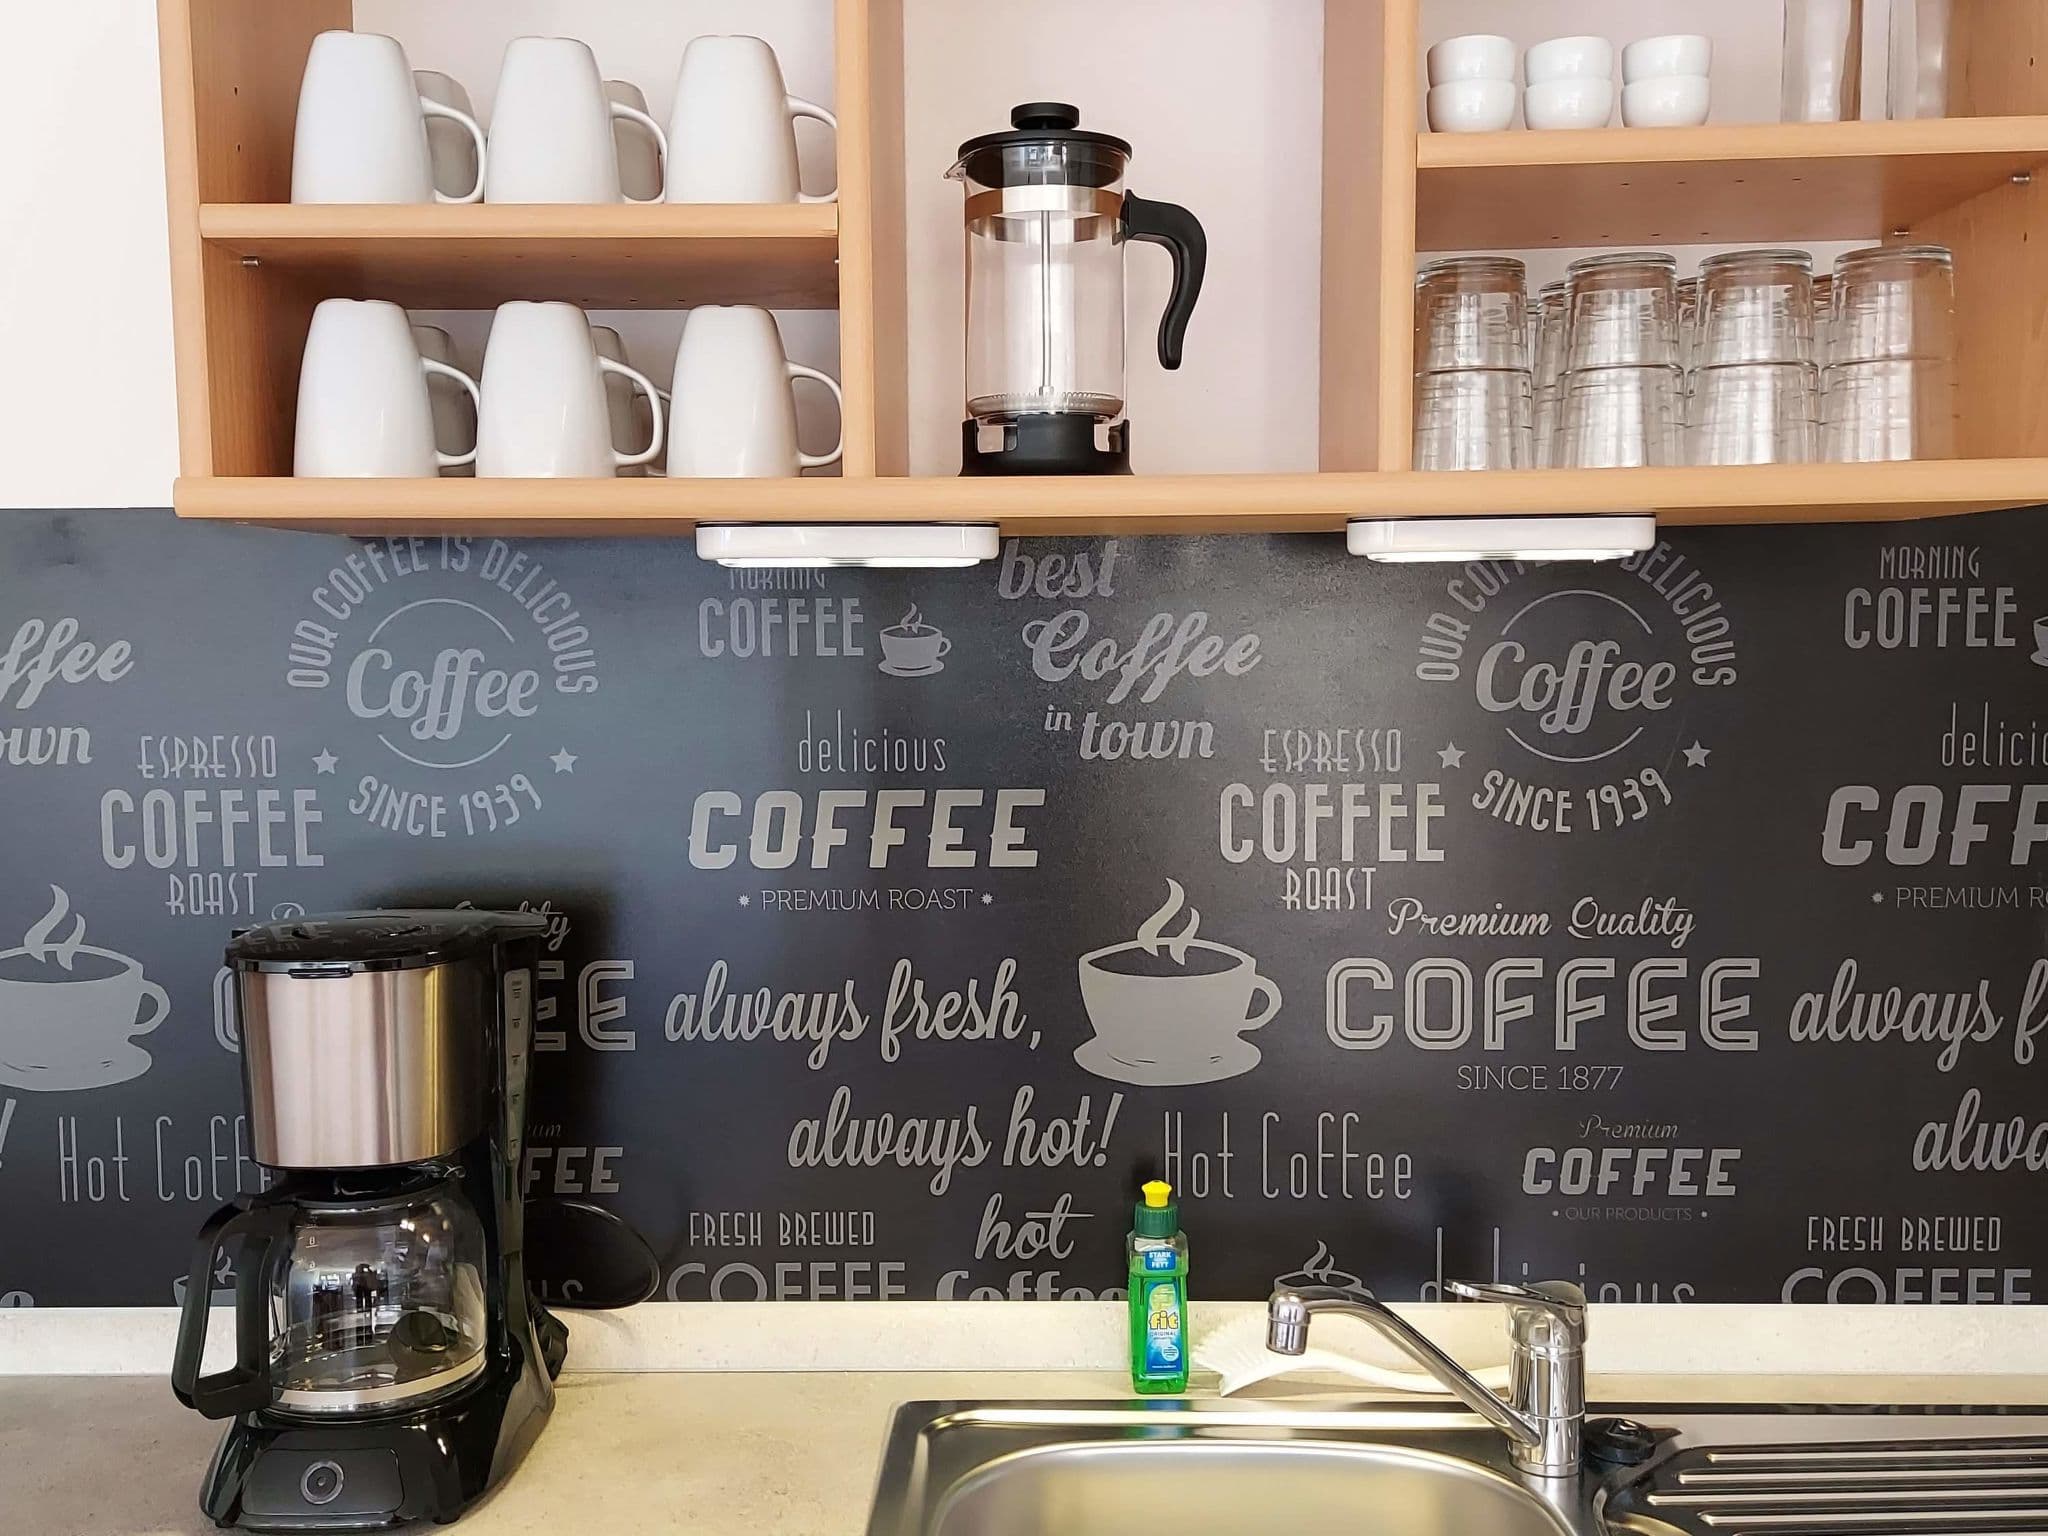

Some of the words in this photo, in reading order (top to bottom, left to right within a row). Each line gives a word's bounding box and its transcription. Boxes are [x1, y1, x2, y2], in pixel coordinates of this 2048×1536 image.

[312, 535, 430, 621] COFFEE
[441, 535, 473, 573] IS
[999, 537, 1122, 600] best
[1880, 546, 1981, 580] MORNING
[480, 538, 600, 694] DELICIOUS
[698, 597, 865, 658] COFFEE
[1415, 612, 1471, 682] OUR
[1843, 586, 2018, 649] COFFEE
[286, 620, 339, 689] OUR
[1021, 609, 1264, 705] Coffee
[346, 648, 540, 741] Coffee
[1474, 639, 1677, 735] Coffee
[137, 735, 278, 779] ESPRESSO
[798, 709, 948, 774] delicious
[1045, 704, 1072, 732] in
[1079, 712, 1216, 761] town
[1258, 728, 1403, 774] ESPRESSO
[100, 788, 325, 869] COFFEE
[348, 775, 447, 838] SINCE
[459, 773, 543, 836] 1939
[688, 789, 1047, 869] COFFEE
[1218, 783, 1446, 865] COFFEE
[1472, 769, 1574, 834] SINCE
[1586, 767, 1673, 831] 1939
[165, 872, 259, 917] ROAST
[761, 889, 879, 913] PREMIUM
[888, 888, 974, 910] ROAST
[1281, 867, 1377, 912] ROAST
[1896, 887, 2019, 909] PREMIUM
[1388, 896, 1552, 939] Premium
[1566, 896, 1697, 950] Quality
[664, 959, 871, 1071] always
[880, 957, 1043, 1064] fresh,
[1324, 957, 1761, 1052] COFFEE
[1788, 957, 2004, 1073] always
[1456, 1065, 1548, 1092] SINCE
[1558, 1065, 1624, 1091] 1877
[58, 1116, 131, 1202] Hot
[155, 1115, 272, 1202] Coff
[786, 1085, 993, 1197] always
[1002, 1084, 1125, 1168] hot!
[1164, 1110, 1235, 1199] Hot
[1262, 1111, 1413, 1200] Coffee
[1579, 1114, 1680, 1140] Premium
[523, 1146, 624, 1195] FEE
[1522, 1147, 1742, 1196] COFFEE
[689, 1211, 762, 1248] FRESH
[779, 1211, 875, 1247] BREWED
[974, 1193, 1095, 1262] hot
[1565, 1206, 1601, 1221] OUR
[1605, 1206, 1693, 1222] PRODUCTS
[1807, 1216, 1884, 1252] FRESH
[1900, 1216, 2002, 1252] BREWED
[1149, 1310, 1179, 1330] fit
